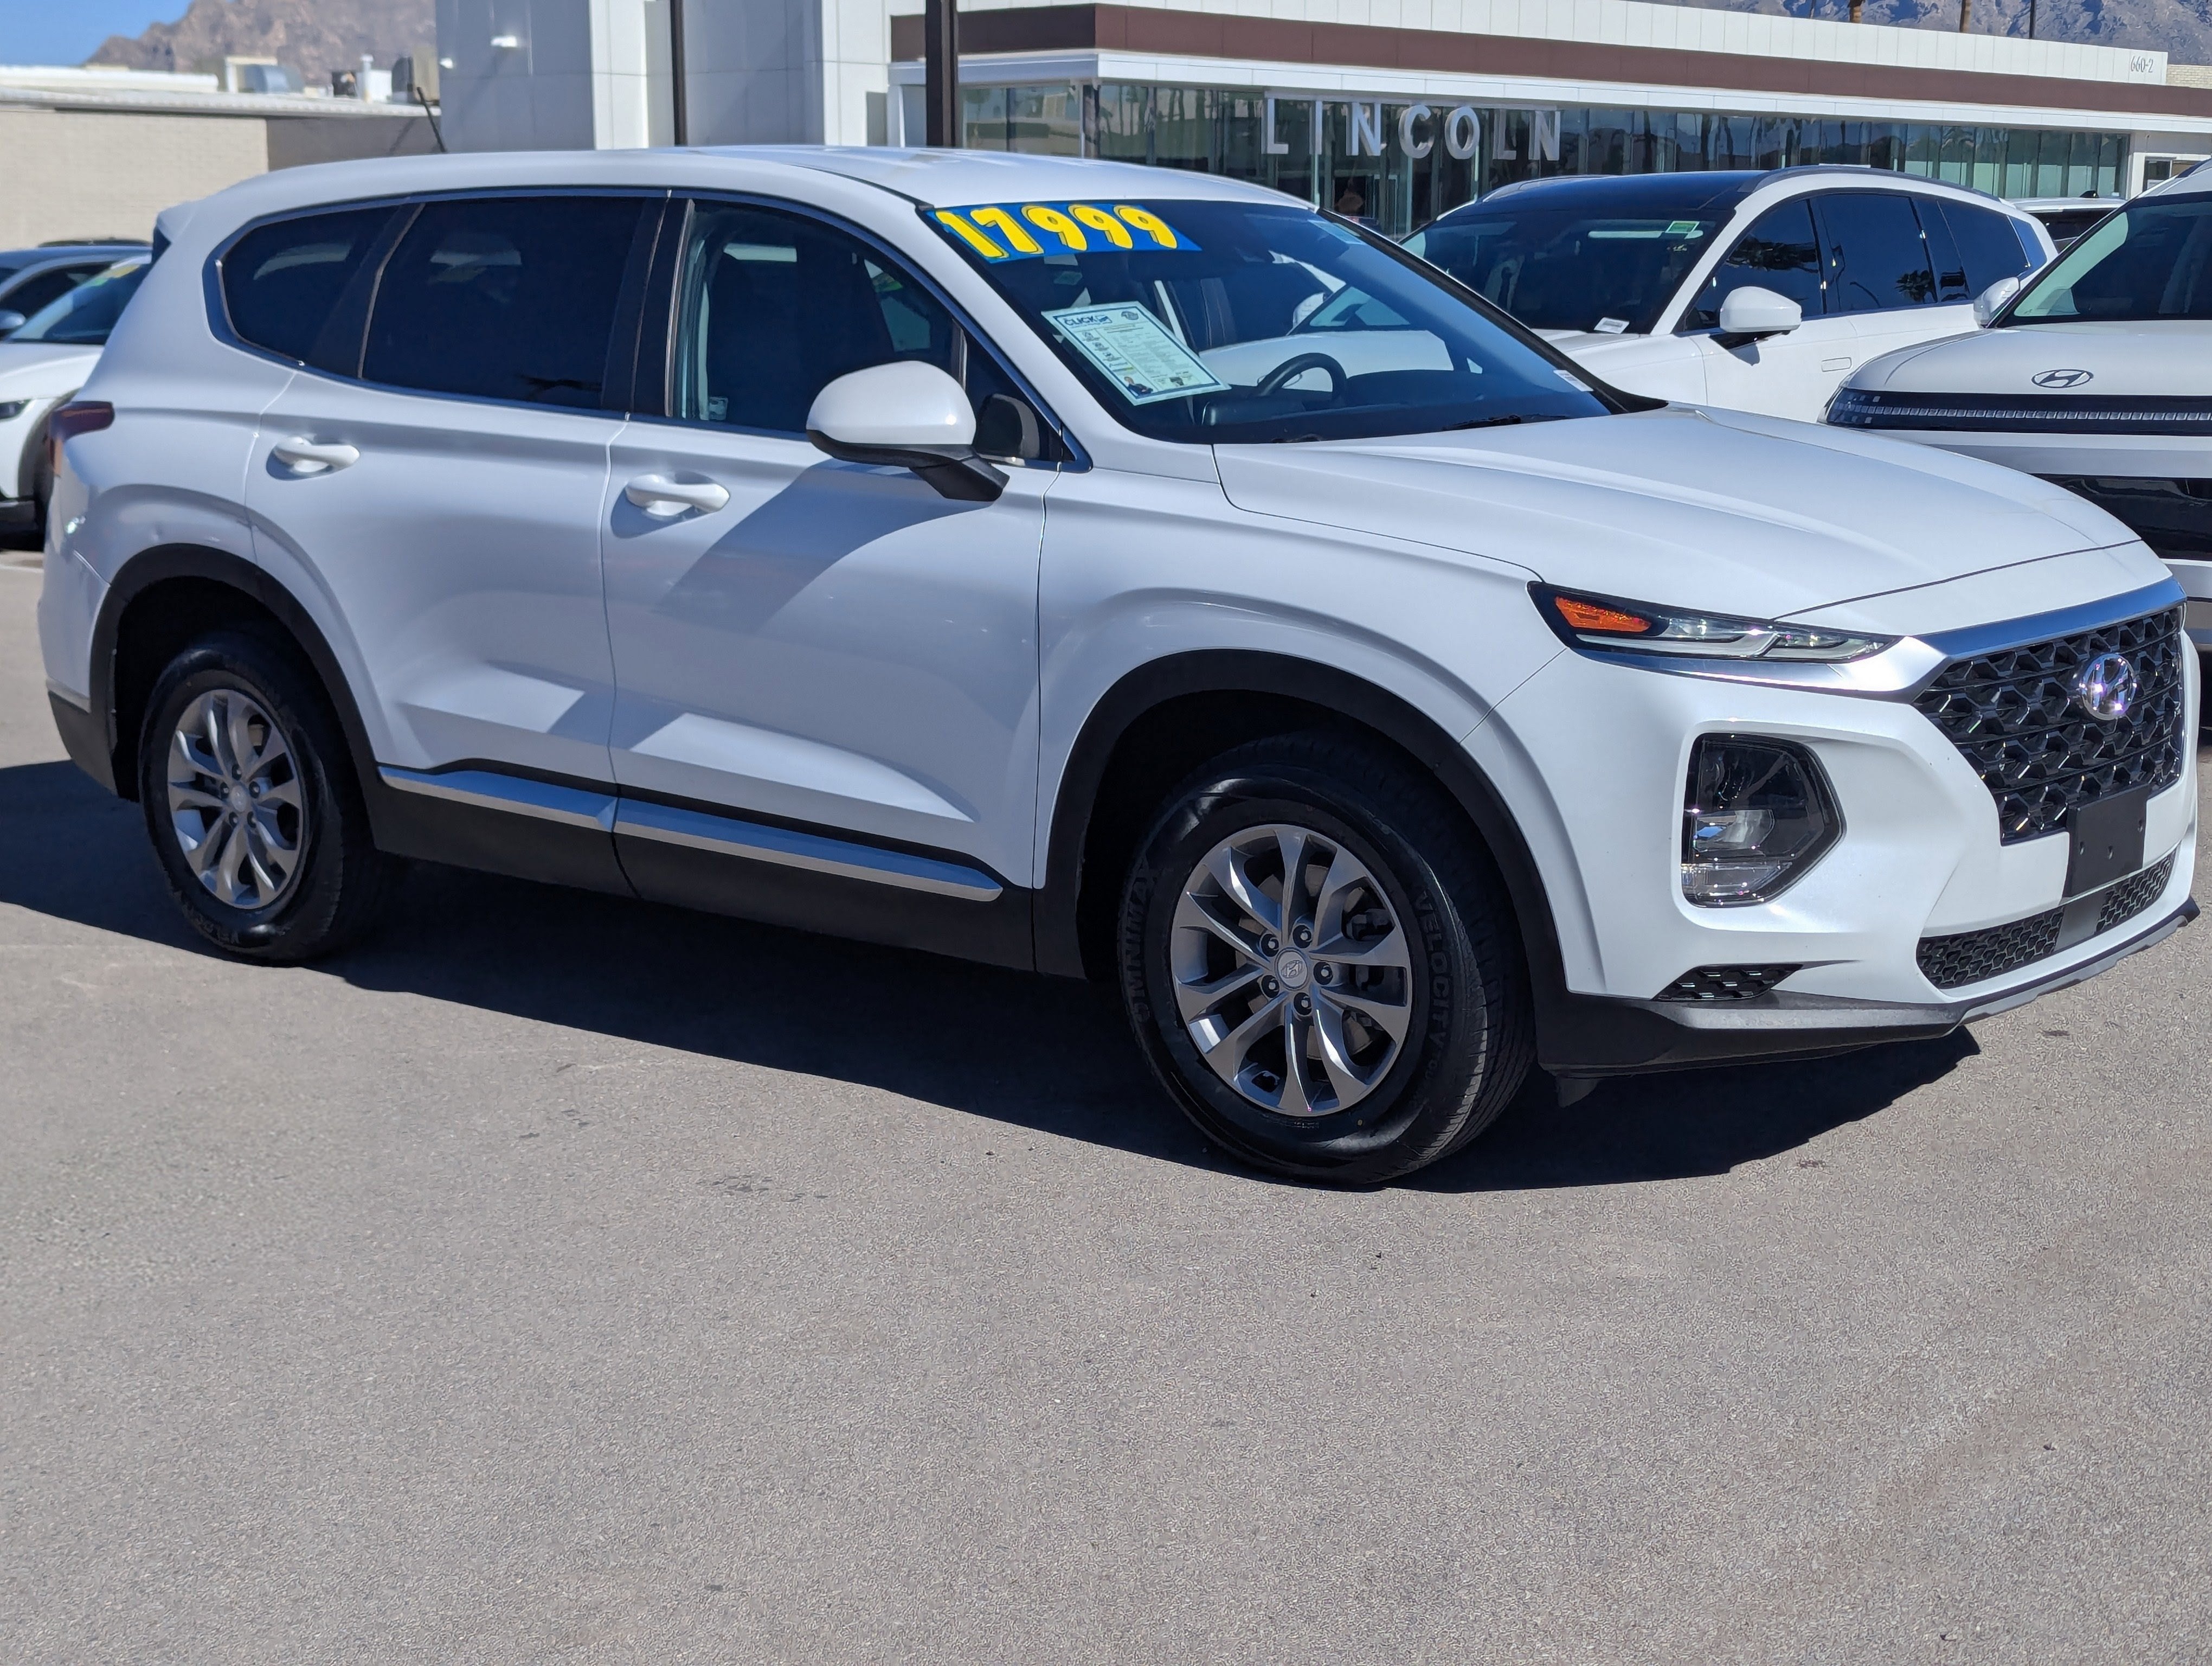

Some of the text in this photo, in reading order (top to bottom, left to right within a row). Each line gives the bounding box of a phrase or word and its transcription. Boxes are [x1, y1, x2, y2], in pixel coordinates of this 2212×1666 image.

[2130, 55, 2153, 73] 660-2
[1261, 98, 1561, 160] LINCOLN
[935, 204, 1178, 258] 17999
[1413, 889, 1450, 1049] VELOCITY
